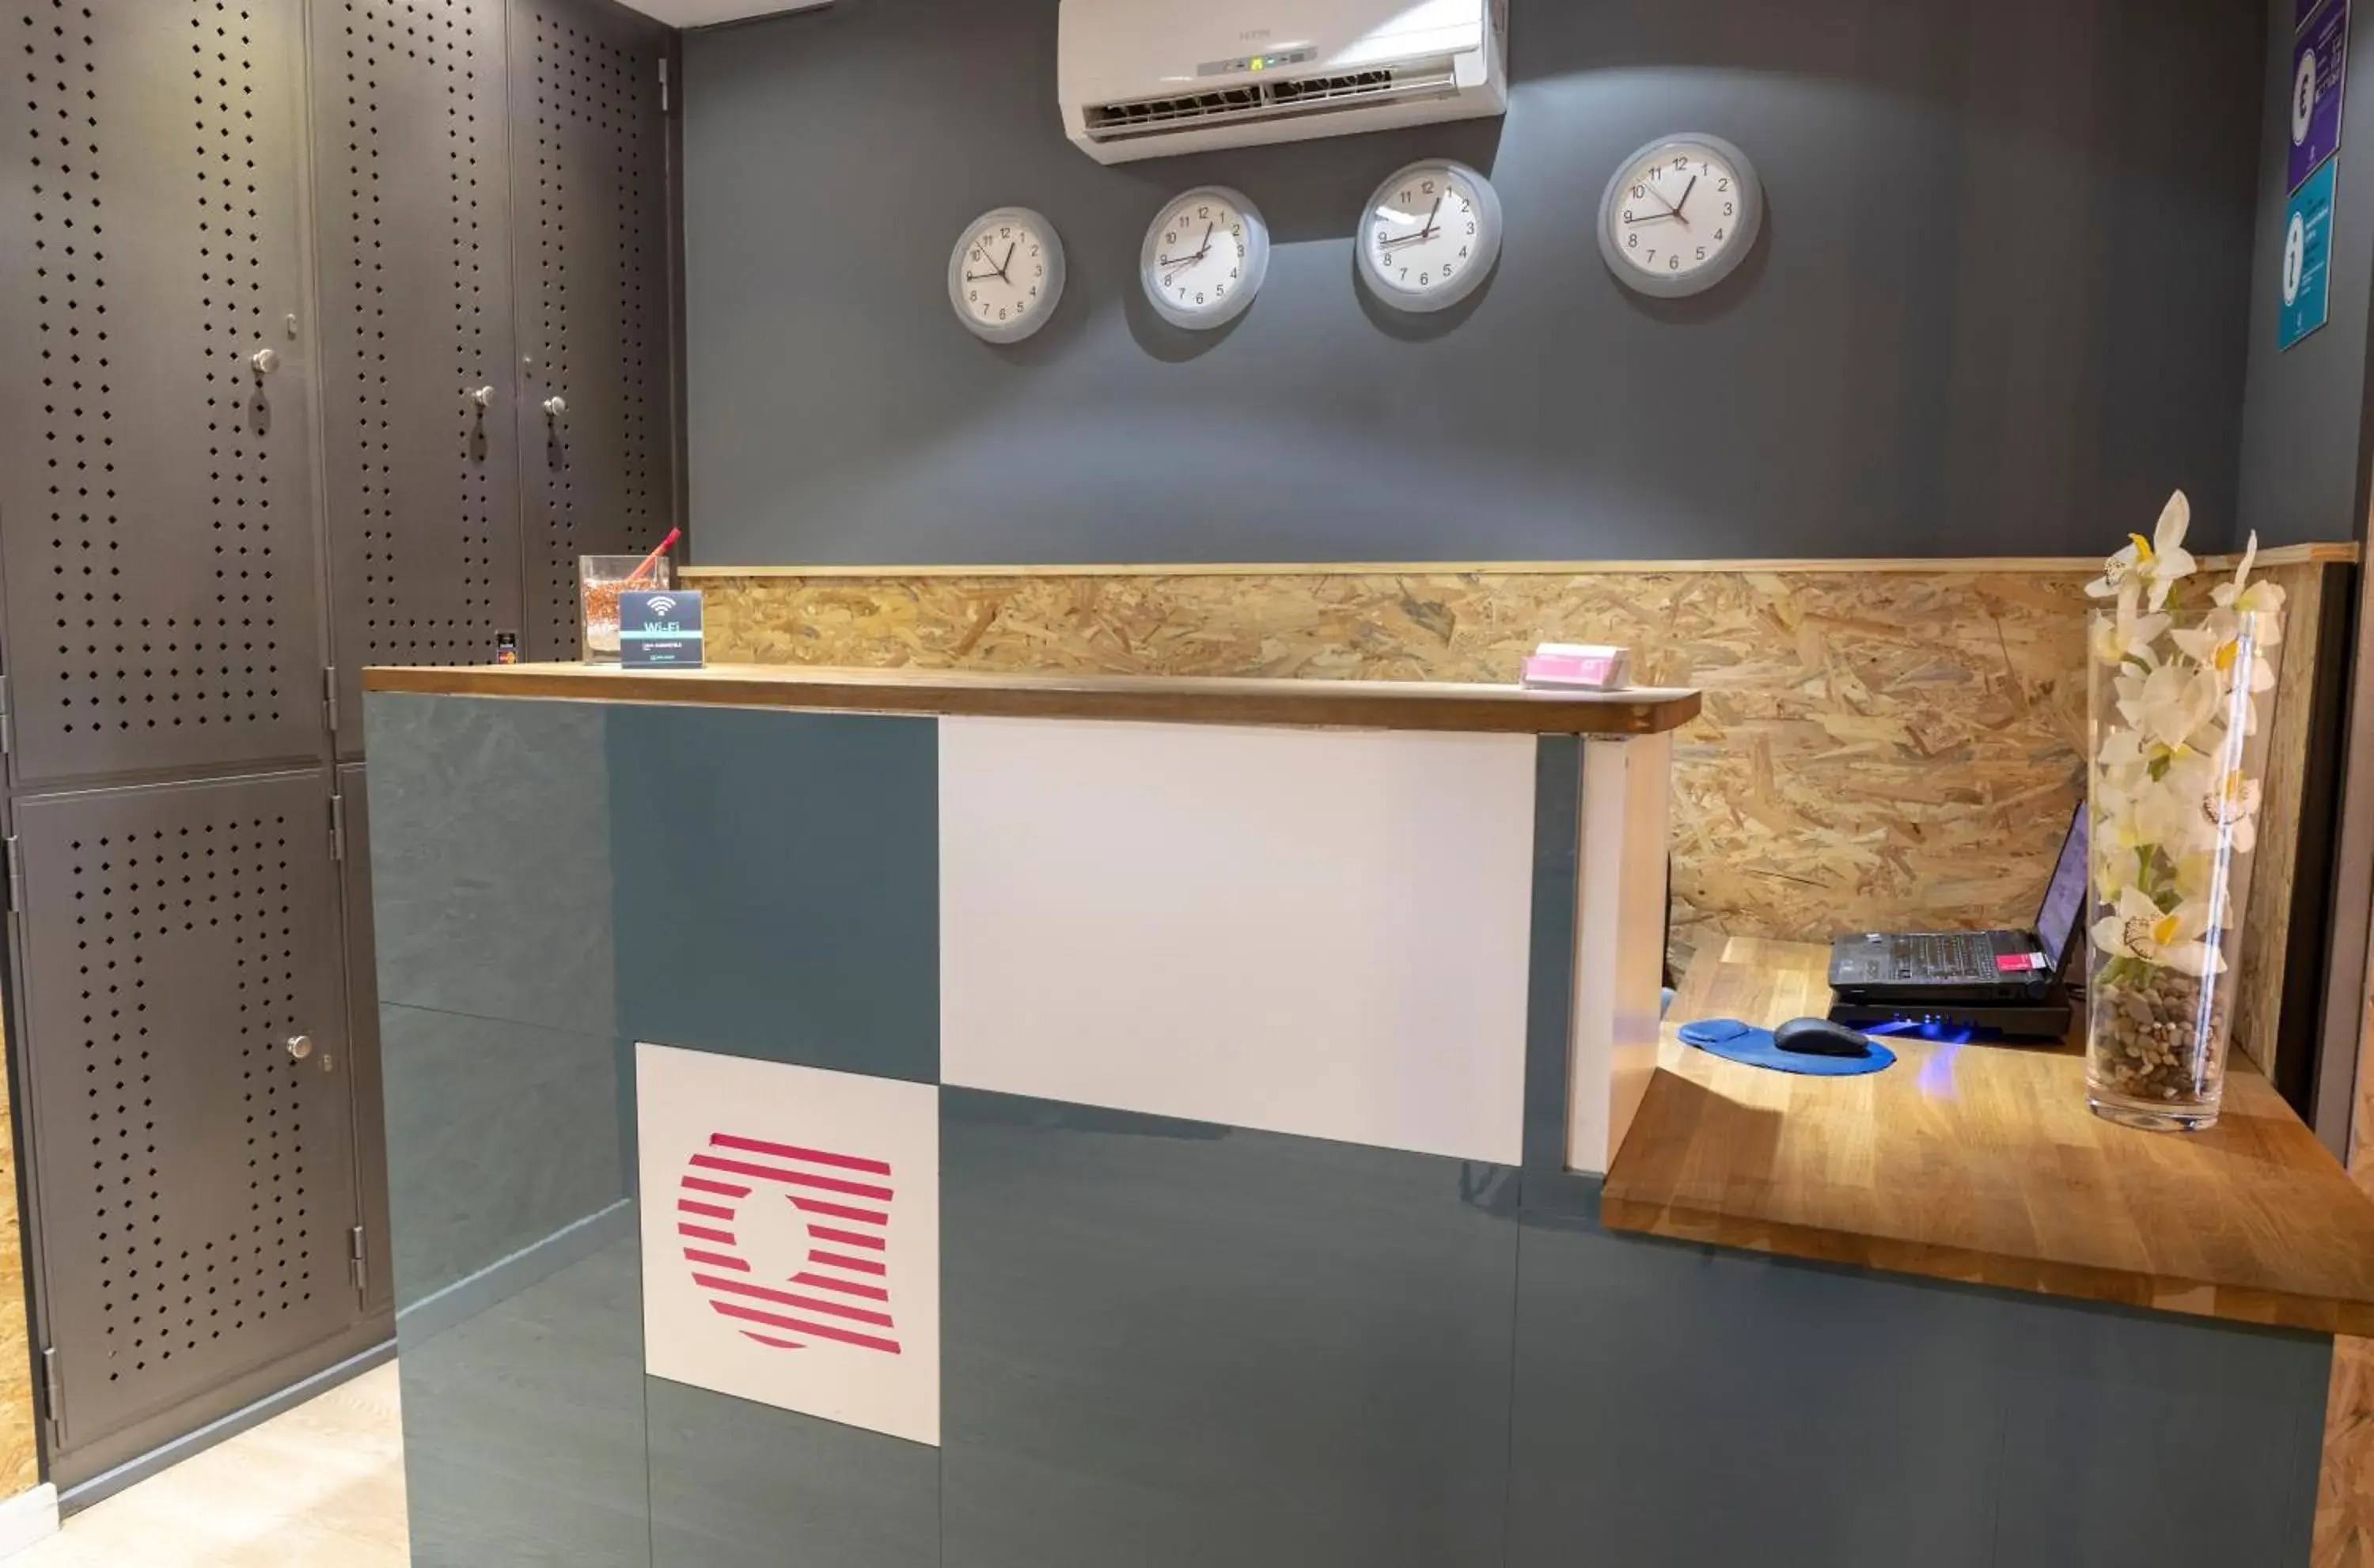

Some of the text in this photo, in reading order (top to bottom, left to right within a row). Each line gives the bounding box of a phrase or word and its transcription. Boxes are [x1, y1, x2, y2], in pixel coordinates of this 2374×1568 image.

[1672, 157, 1688, 171] 12
[1701, 163, 1708, 176] 1
[1648, 168, 1661, 180] 11
[1421, 181, 1434, 194] 12
[1717, 179, 1728, 192] 2
[1400, 191, 1411, 203] 11
[1446, 187, 1452, 197] 1
[1632, 185, 1644, 199] 10
[1197, 206, 1208, 218] 12
[1462, 199, 1470, 213] 2
[1723, 203, 1732, 216] 3
[1179, 217, 1189, 227] 11
[1219, 210, 1225, 222] 1
[1623, 210, 1633, 224] 9
[1000, 227, 1011, 238] 12
[1232, 225, 1240, 236] 2
[1466, 222, 1474, 235] 3
[983, 236, 993, 246] 11
[1020, 233, 1025, 243] 1
[1166, 233, 1176, 244] 10
[1378, 232, 1387, 244] 9
[1628, 234, 1637, 248] 8
[1713, 229, 1723, 241] 4
[1031, 244, 1039, 256] 2
[1238, 245, 1245, 256] 3
[1458, 246, 1466, 258] 4
[1696, 247, 1705, 260] 5
[1161, 255, 1167, 265] 9
[1383, 254, 1391, 266] 8
[1647, 250, 1655, 263] 7
[1669, 256, 1678, 270] 6
[966, 271, 973, 282] 9
[1036, 266, 1041, 276] 3
[1231, 267, 1237, 278] 4
[1400, 268, 1408, 280] 7
[1443, 264, 1451, 277] 5
[1164, 275, 1171, 286] 8
[1420, 272, 1428, 285] 6
[970, 290, 977, 301] 8
[1030, 286, 1036, 296] 4
[1179, 288, 1186, 299] 7
[1216, 285, 1224, 296] 5
[1196, 293, 1204, 304] 6
[984, 304, 990, 315] 7
[1017, 301, 1024, 312] 5
[999, 309, 1006, 320] 6
[643, 621, 680, 632] Wi-Fi
